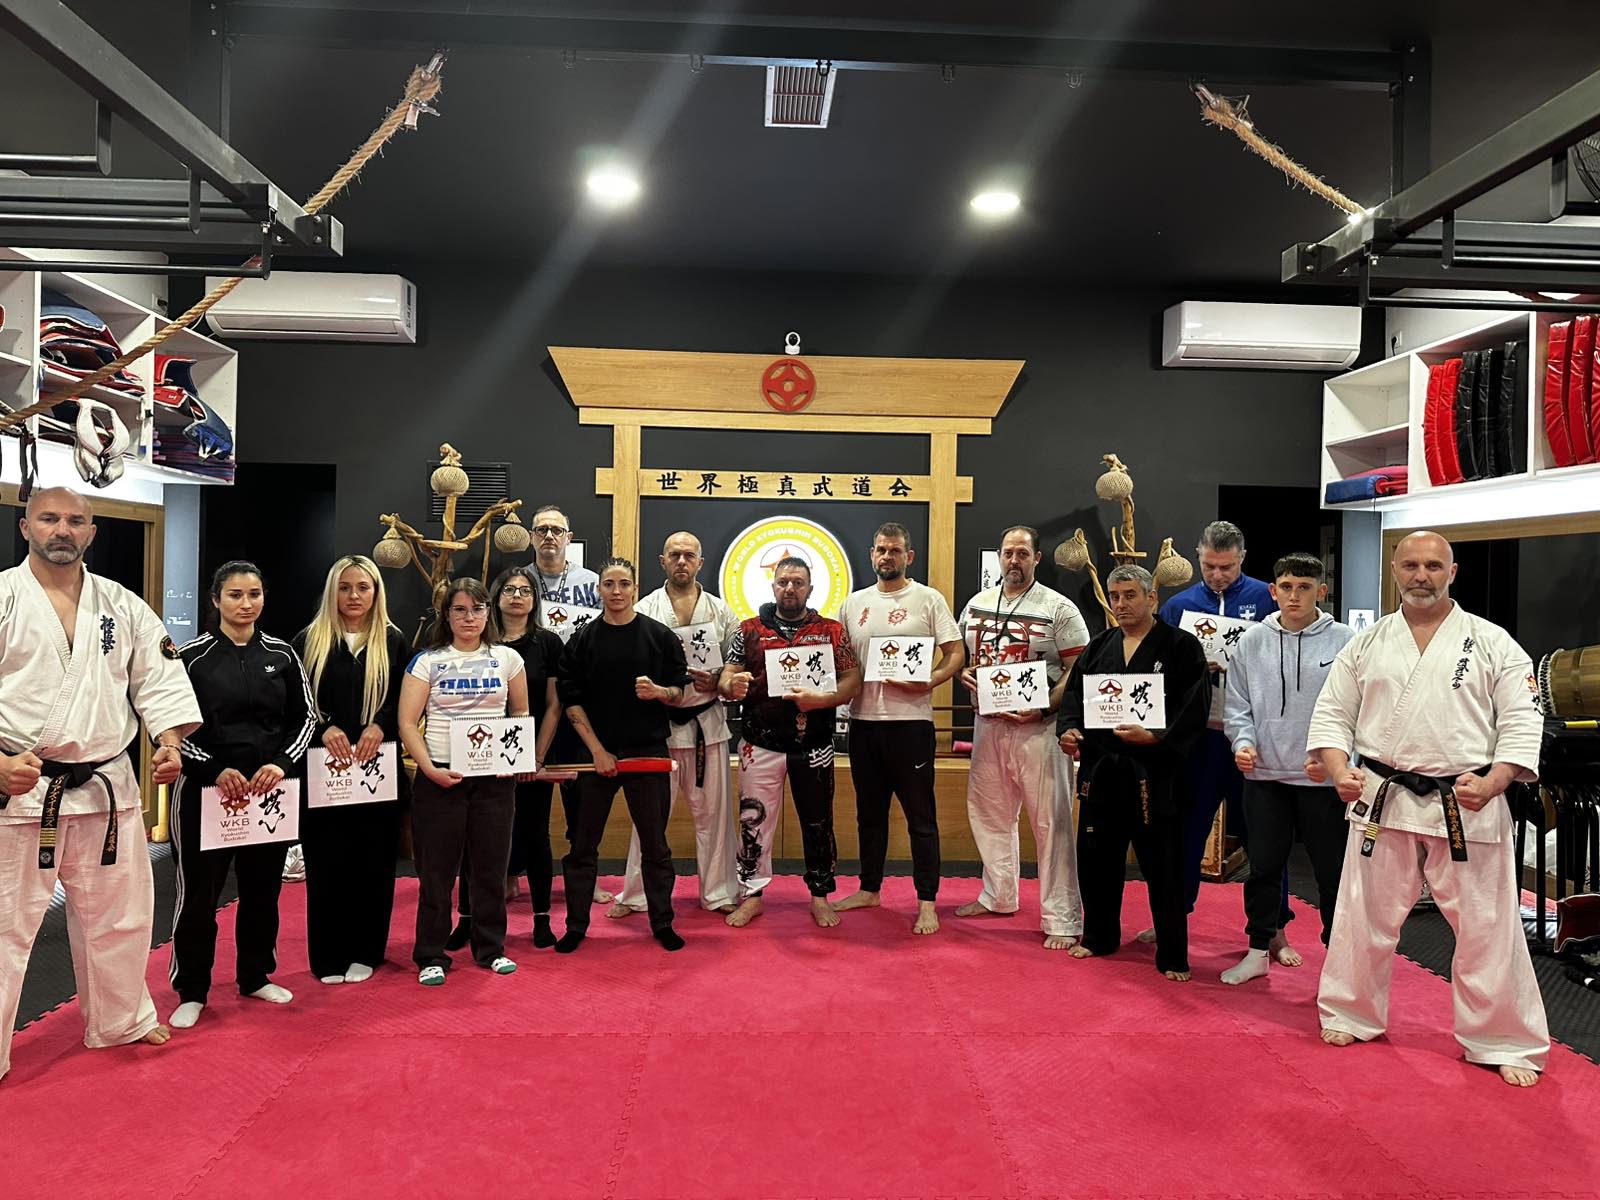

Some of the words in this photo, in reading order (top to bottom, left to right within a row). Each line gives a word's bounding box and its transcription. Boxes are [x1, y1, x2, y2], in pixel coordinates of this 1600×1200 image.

[439, 677, 501, 690] ITALIA
[991, 690, 1012, 698] WKB
[1099, 704, 1123, 712] WKB
[467, 750, 493, 758] WKB
[325, 779, 353, 787] WKB
[220, 818, 250, 828] WKB
